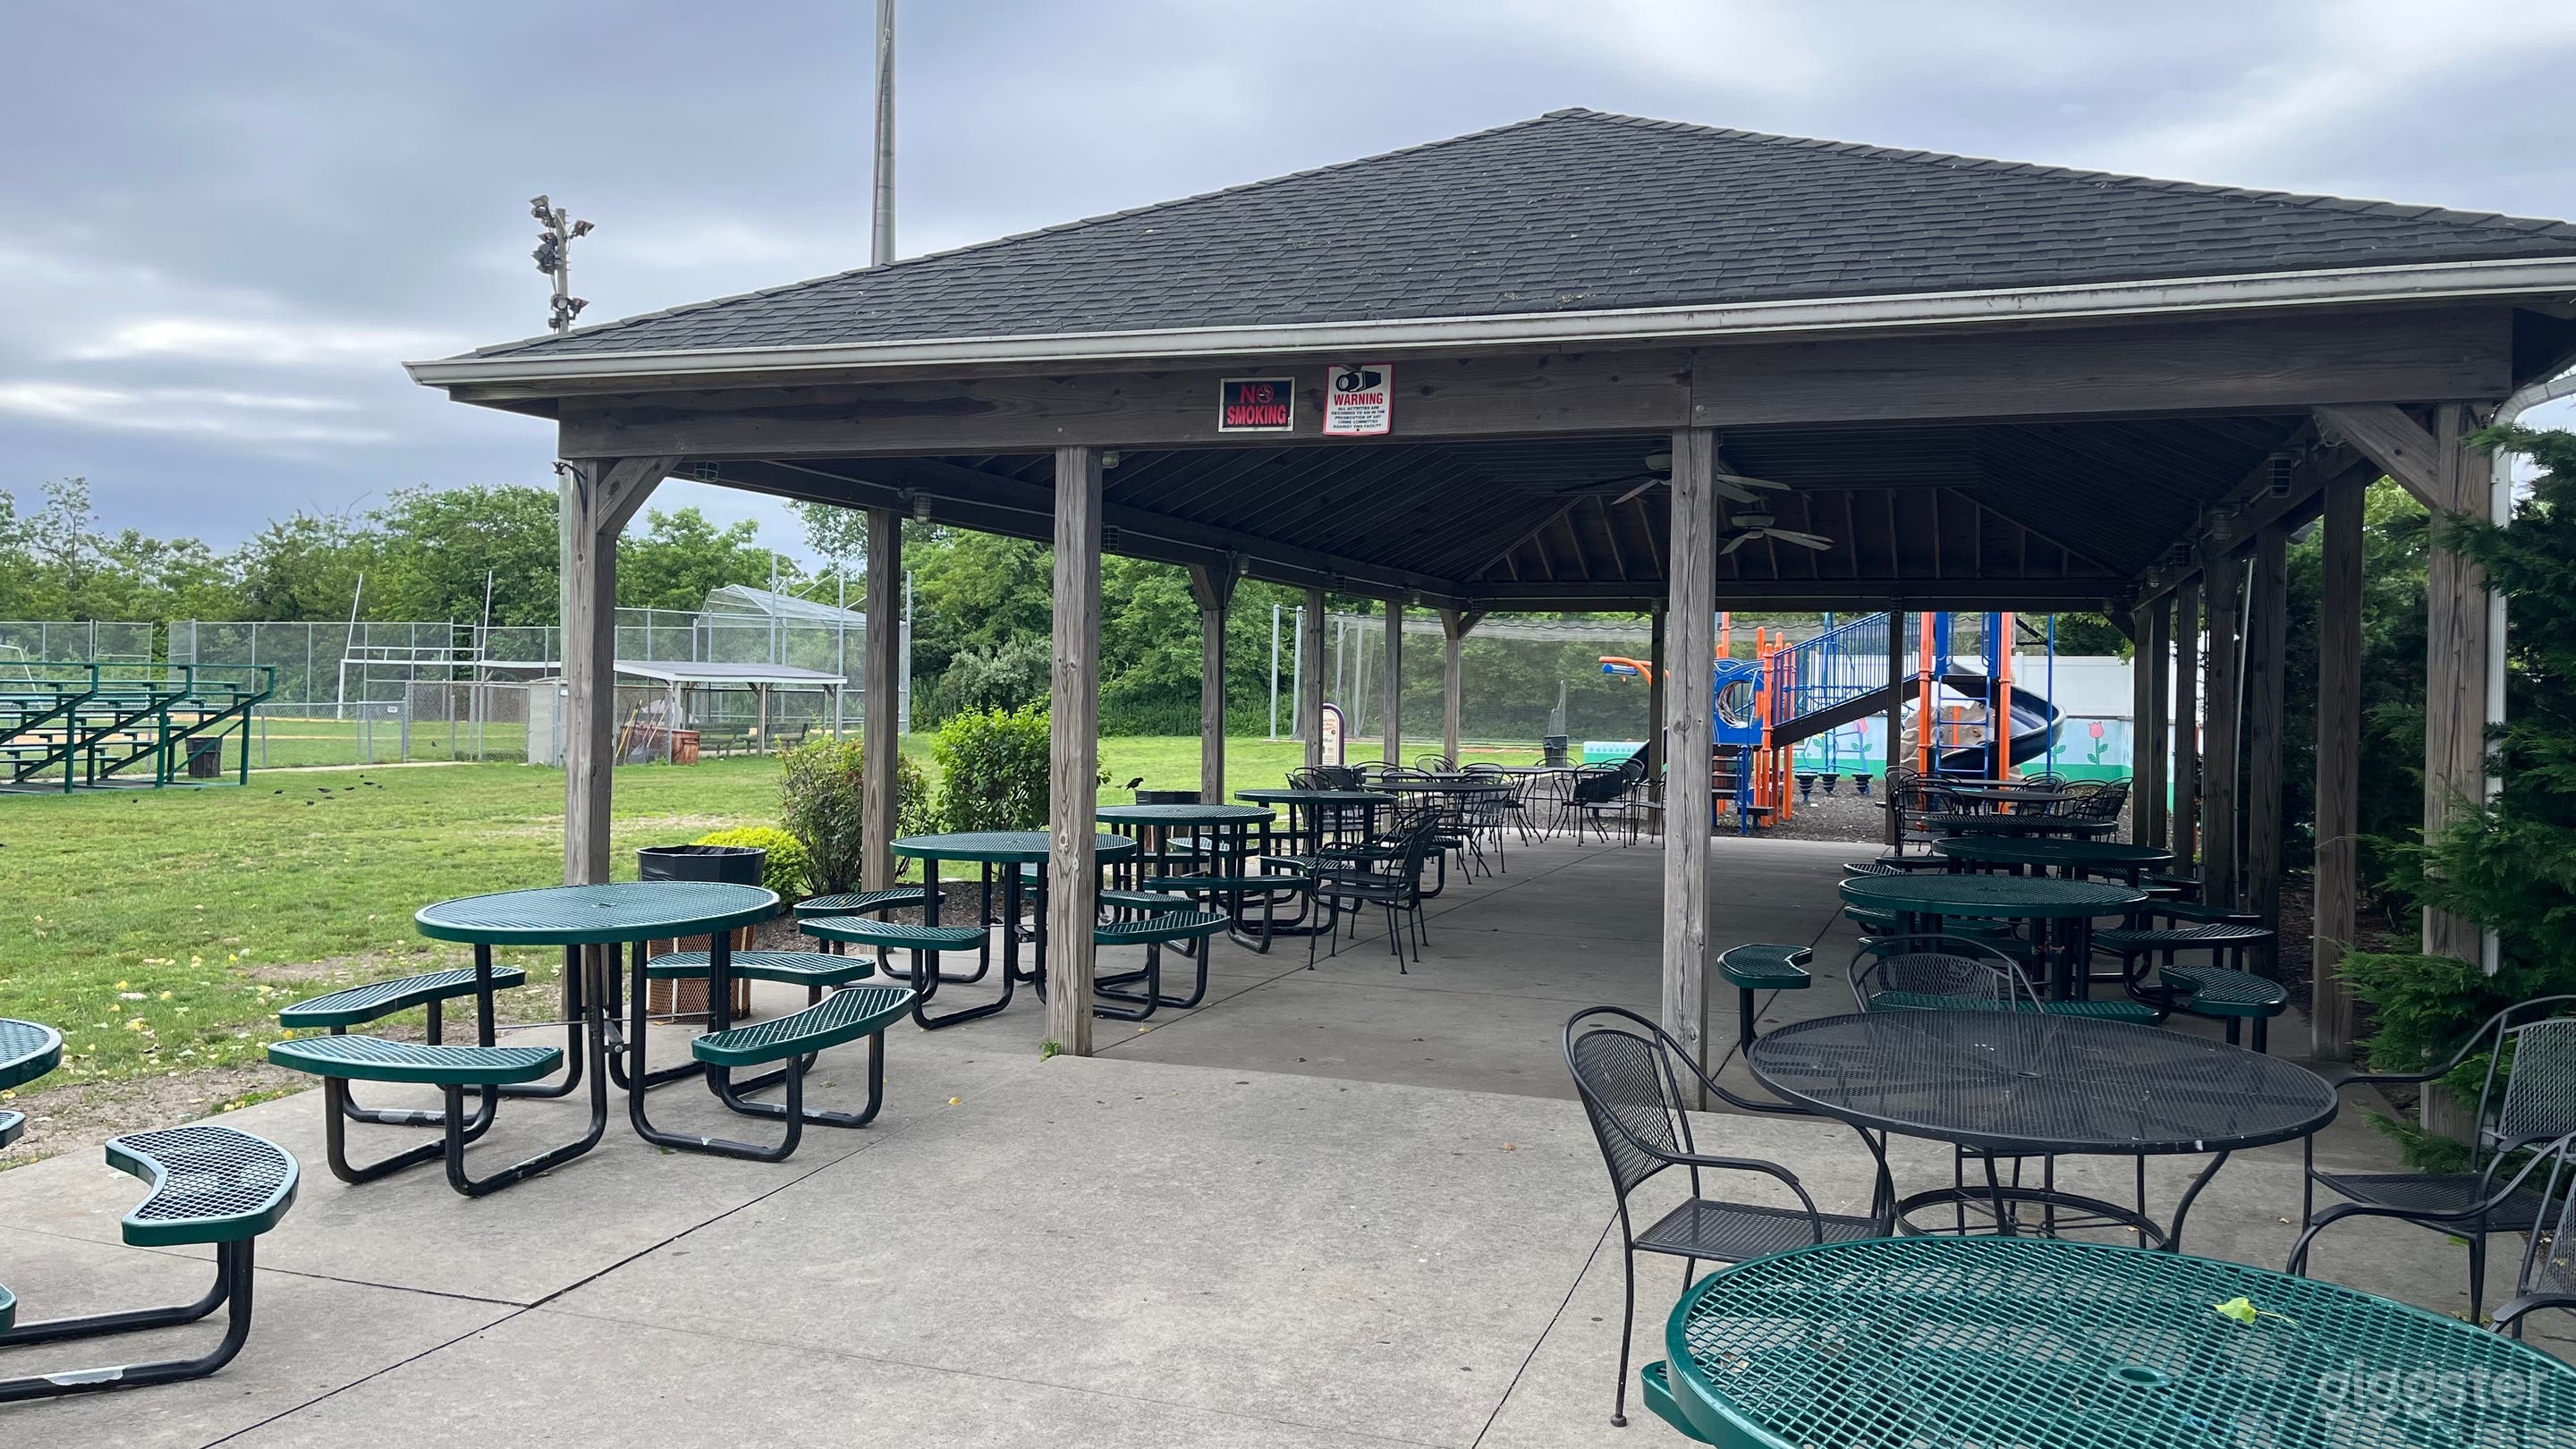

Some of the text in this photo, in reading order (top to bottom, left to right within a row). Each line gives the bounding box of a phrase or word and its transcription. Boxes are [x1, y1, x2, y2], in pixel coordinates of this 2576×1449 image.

[1240, 385, 1275, 403] NO
[1334, 393, 1384, 406] WARNING
[1226, 405, 1286, 425] SMOKING
